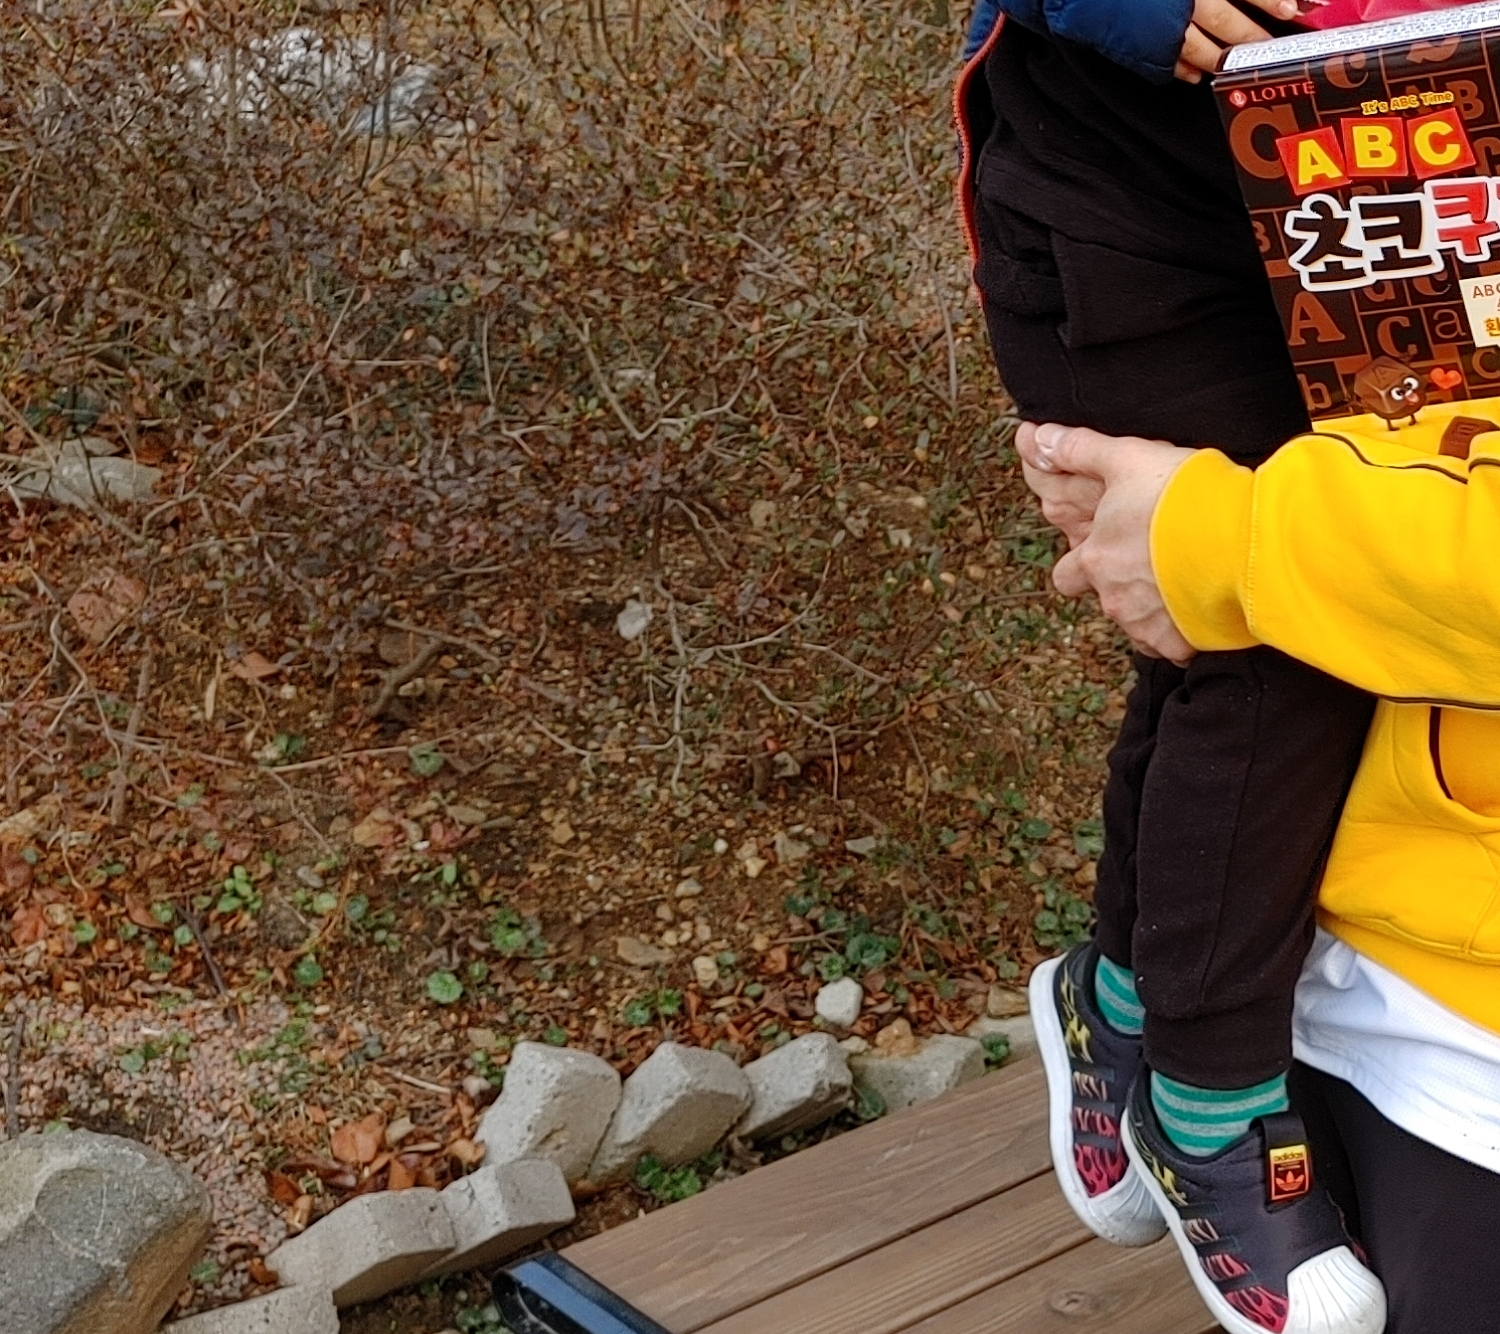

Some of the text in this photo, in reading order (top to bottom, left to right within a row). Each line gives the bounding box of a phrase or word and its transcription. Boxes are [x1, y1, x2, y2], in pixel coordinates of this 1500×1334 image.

[1250, 80, 1316, 103] LOTTE
[1390, 94, 1419, 110] ABC
[1422, 91, 1453, 105] Time
[1298, 121, 1461, 185] ABC
